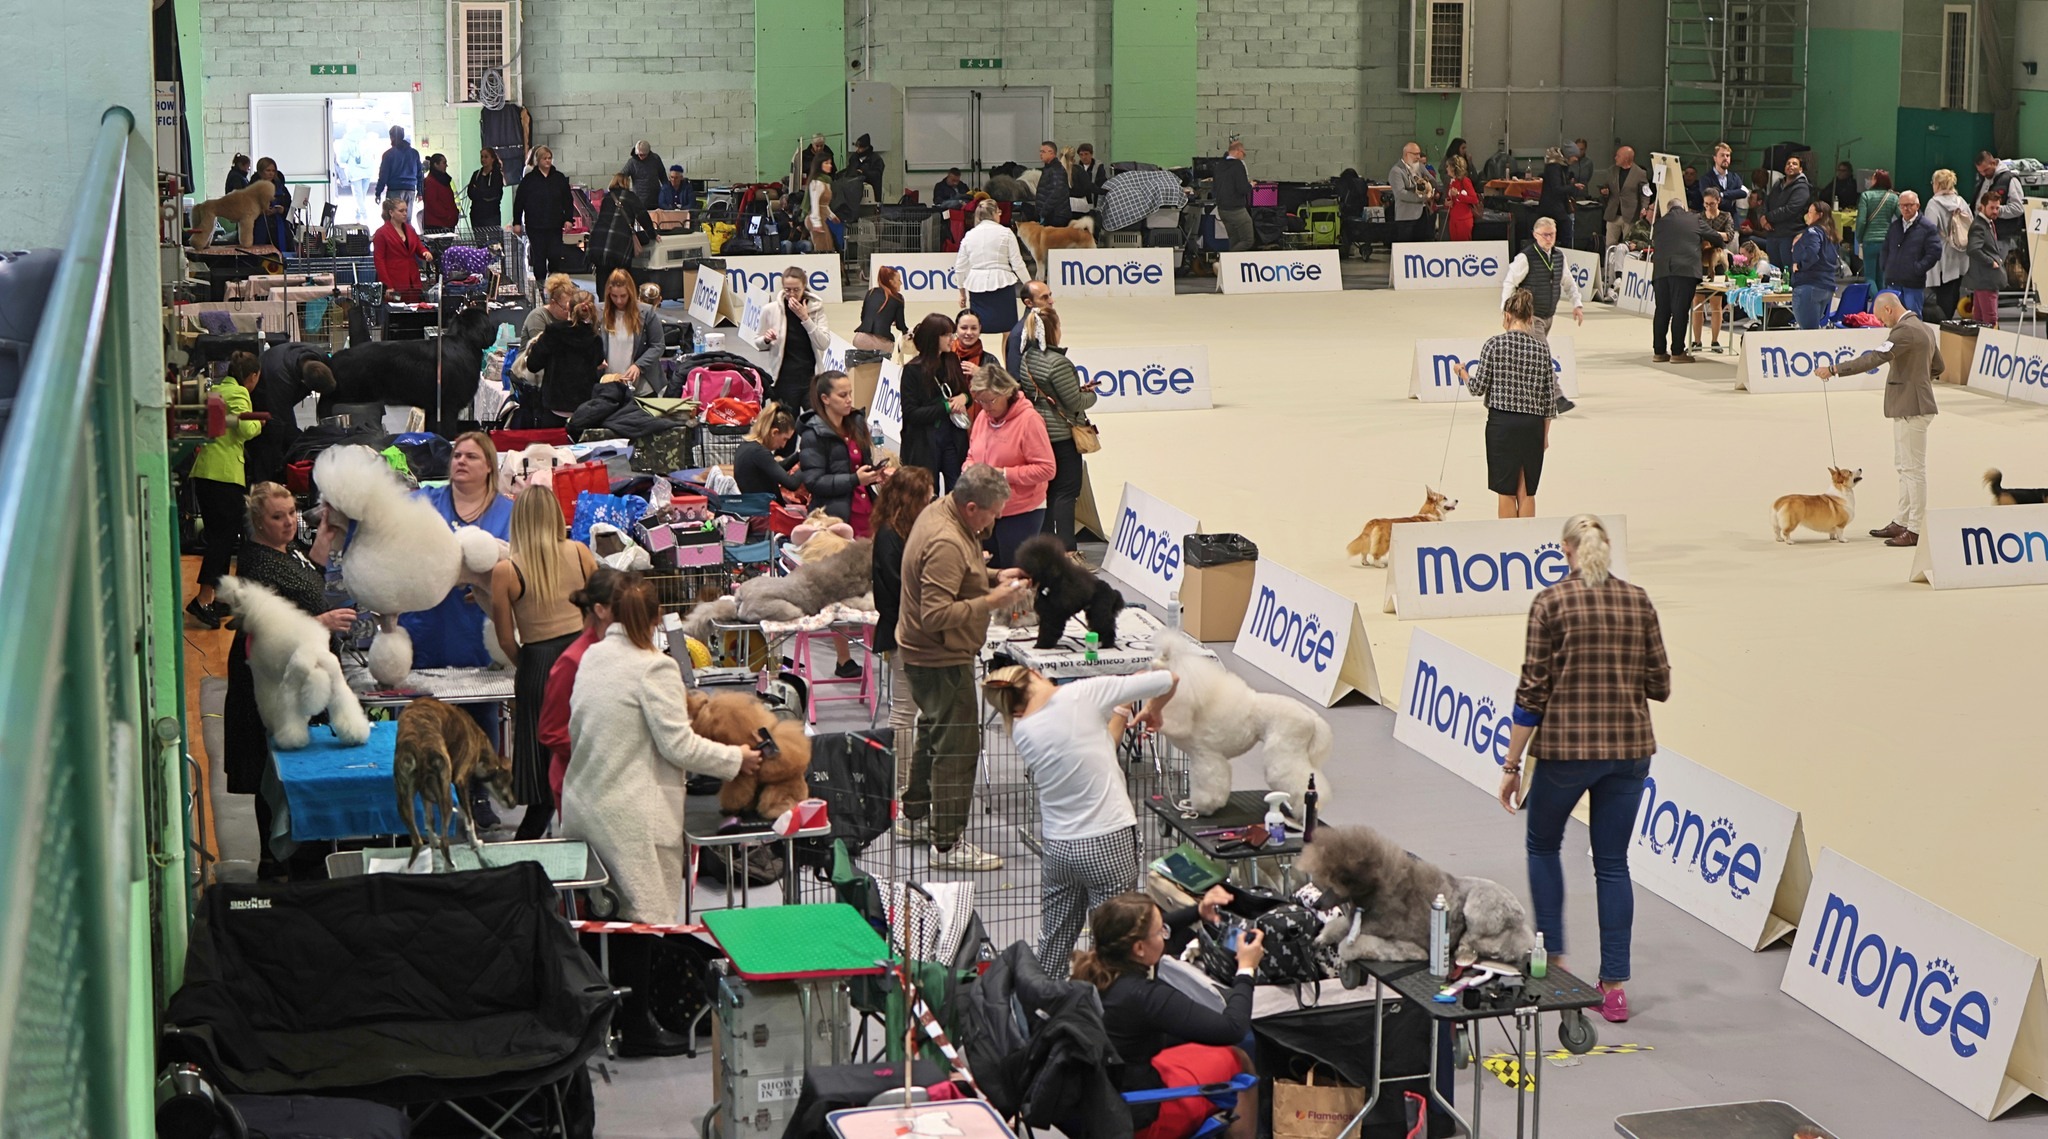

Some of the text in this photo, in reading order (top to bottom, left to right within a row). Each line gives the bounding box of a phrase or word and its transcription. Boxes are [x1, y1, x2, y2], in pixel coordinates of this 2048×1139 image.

[2034, 217, 2042, 231] 2
[761, 1080, 793, 1091] SHOW
[761, 1087, 802, 1099] IN TRA
